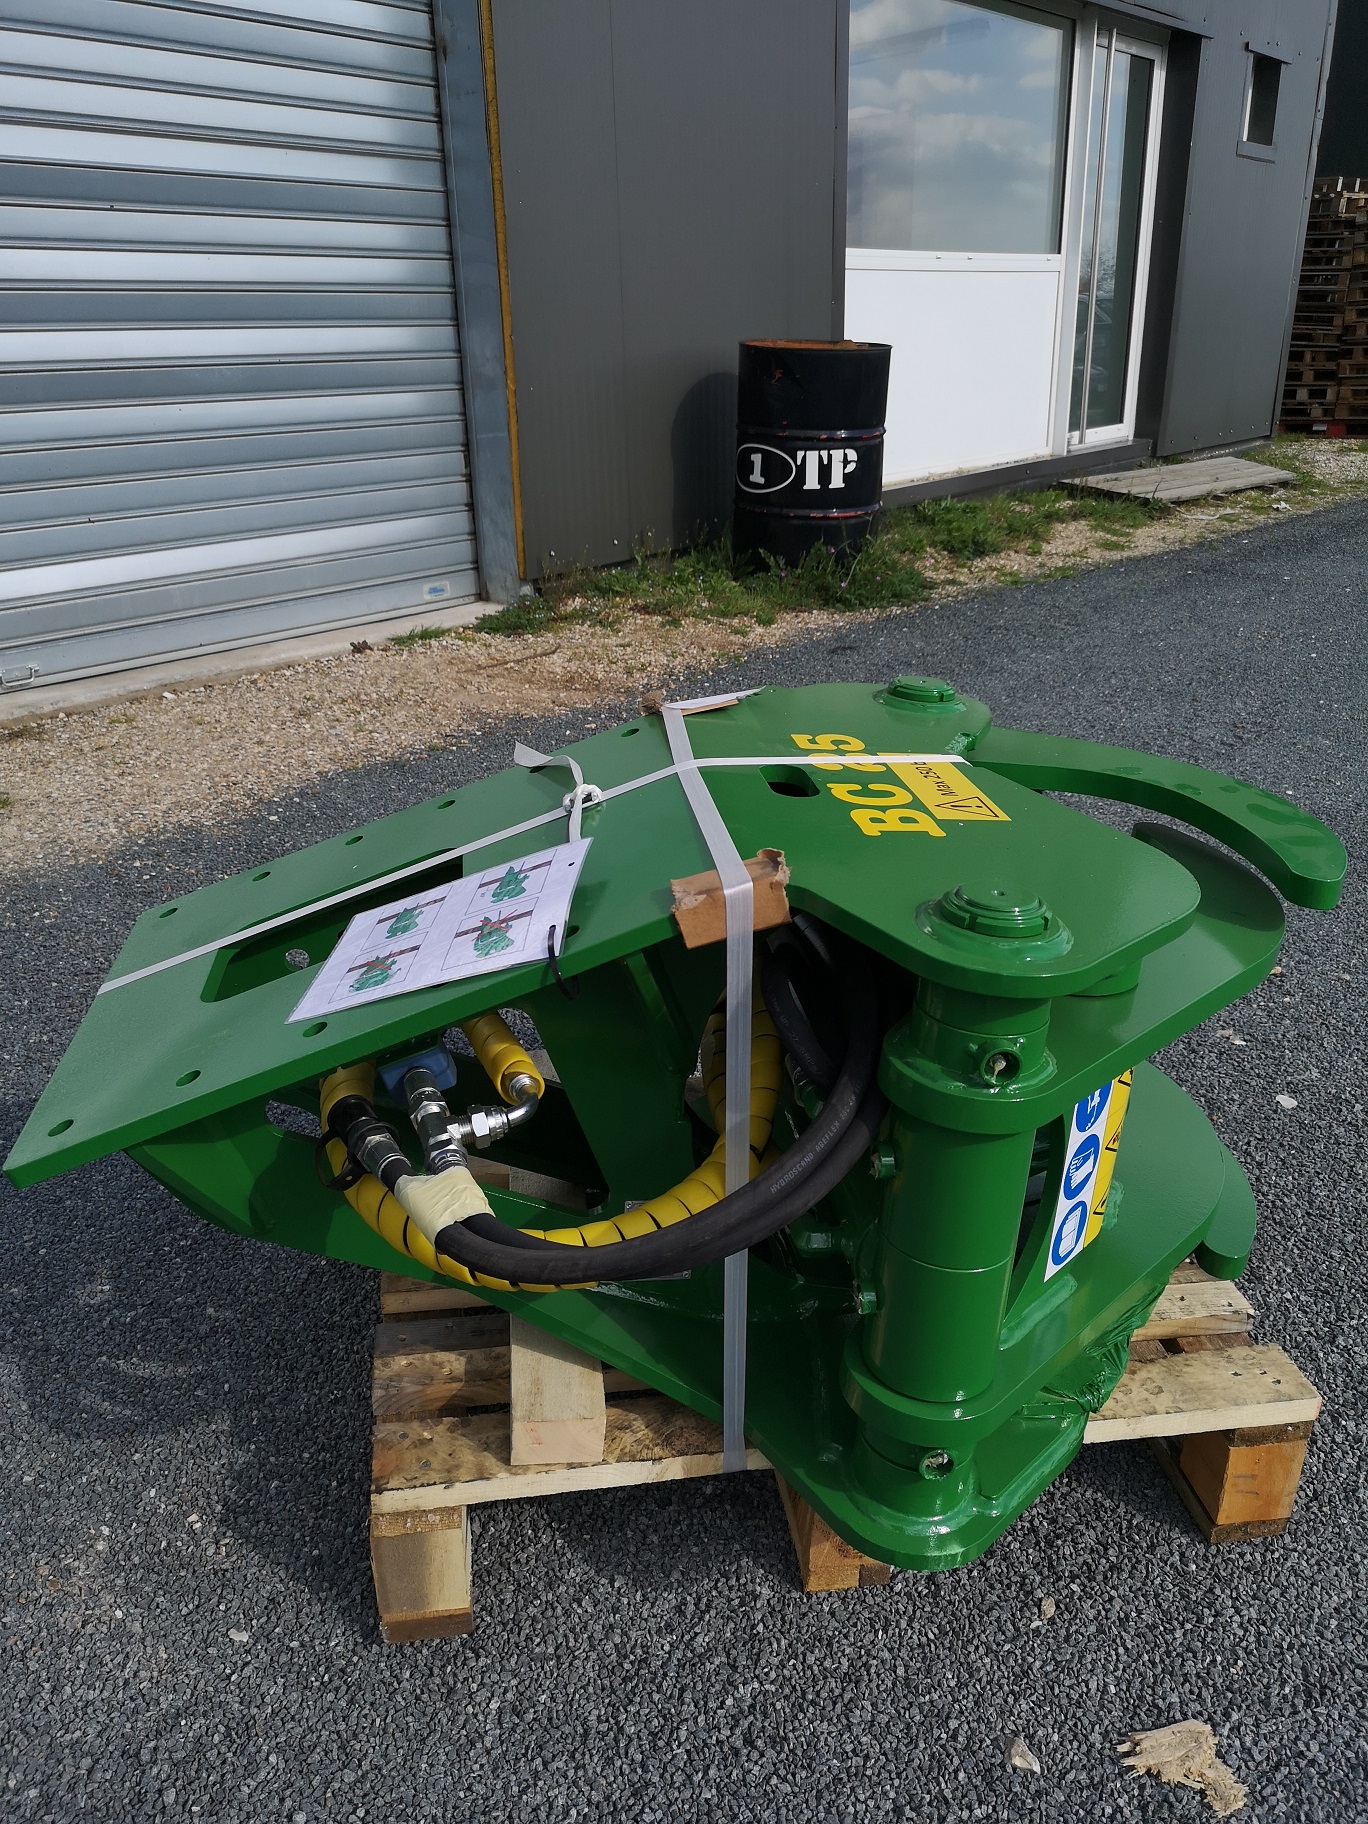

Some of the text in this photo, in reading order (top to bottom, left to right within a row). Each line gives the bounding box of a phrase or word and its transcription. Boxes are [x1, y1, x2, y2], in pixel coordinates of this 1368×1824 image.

[796, 448, 858, 490] TP
[915, 766, 959, 797] Max 250
[826, 783, 947, 837] BC
